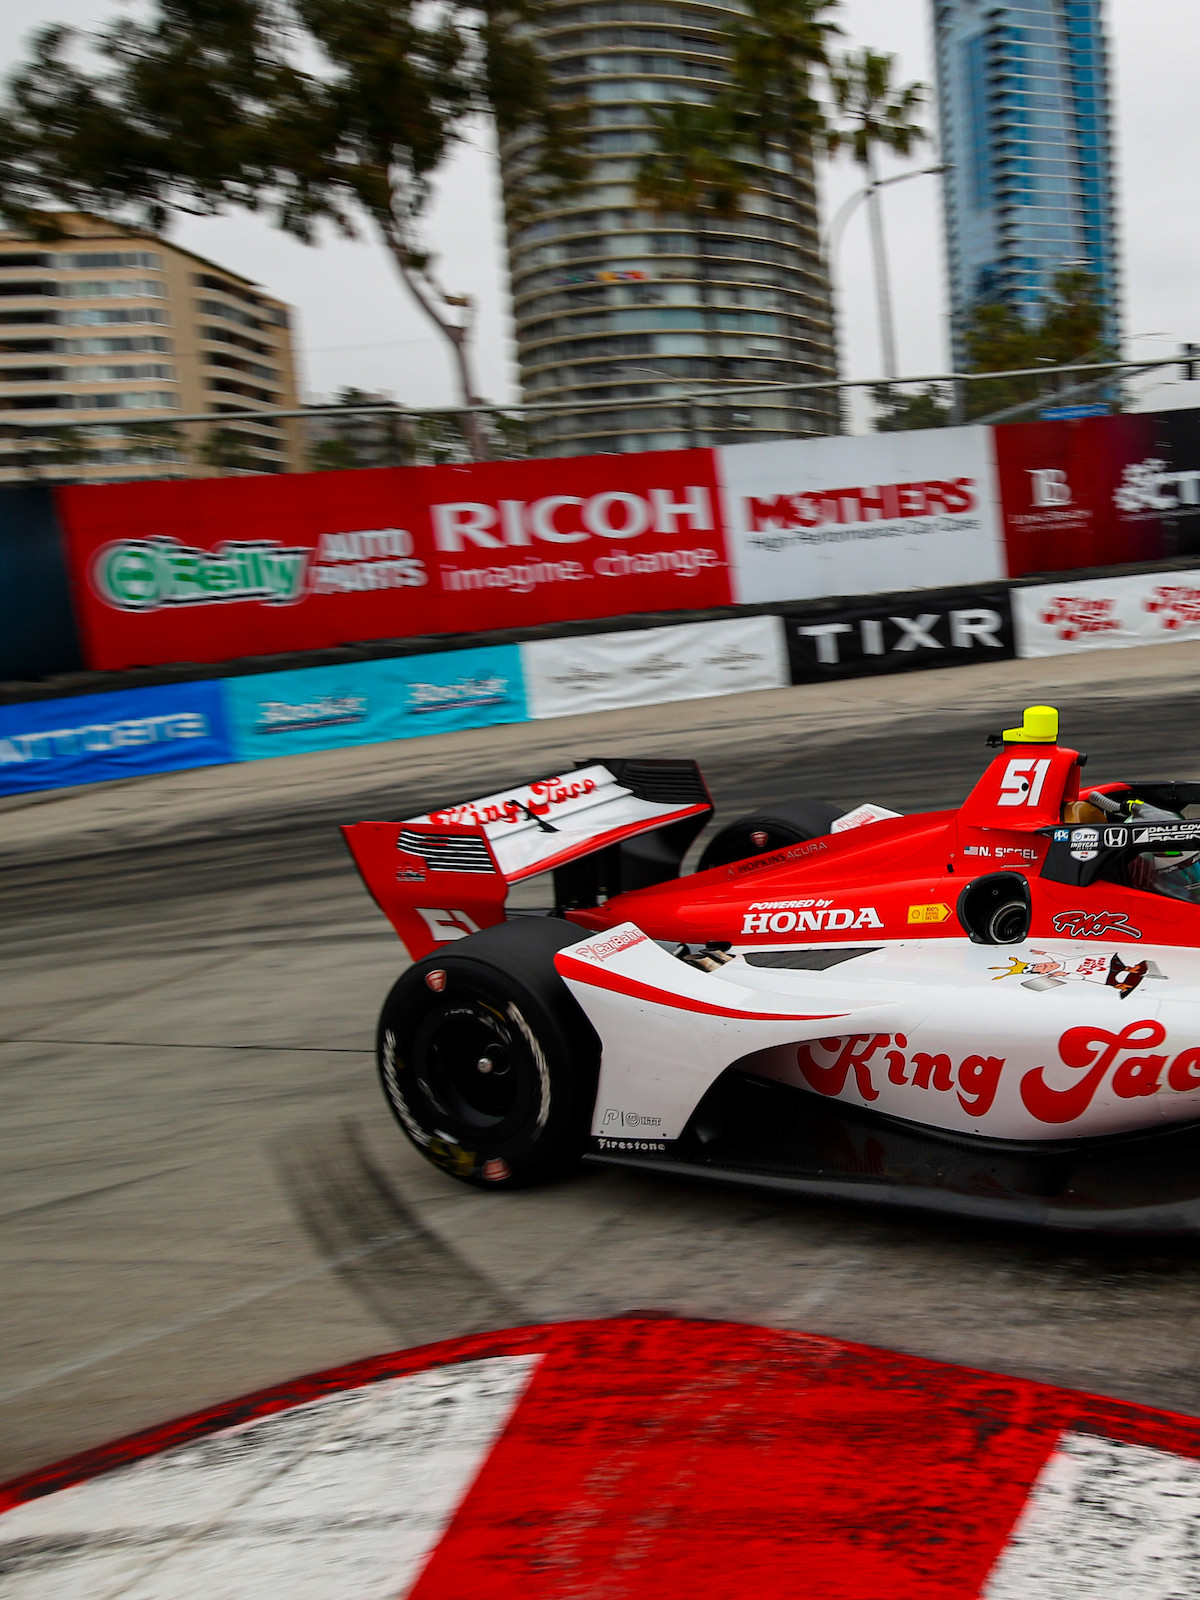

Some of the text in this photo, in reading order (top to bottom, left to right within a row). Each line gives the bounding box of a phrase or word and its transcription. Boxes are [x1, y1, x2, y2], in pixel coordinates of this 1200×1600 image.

[429, 486, 715, 552] RICOH
[797, 608, 1004, 664] TIXR
[997, 759, 1051, 807] 51
[528, 776, 597, 816] Taco
[1054, 829, 1069, 842] PPG
[1149, 825, 1178, 833] DALE
[786, 841, 828, 860] ACURA
[979, 846, 992, 857] N.
[748, 899, 834, 911] POWERED by
[740, 907, 885, 935] HONDA
[797, 1031, 1006, 1118] King
[597, 1138, 666, 1151] Firestone
